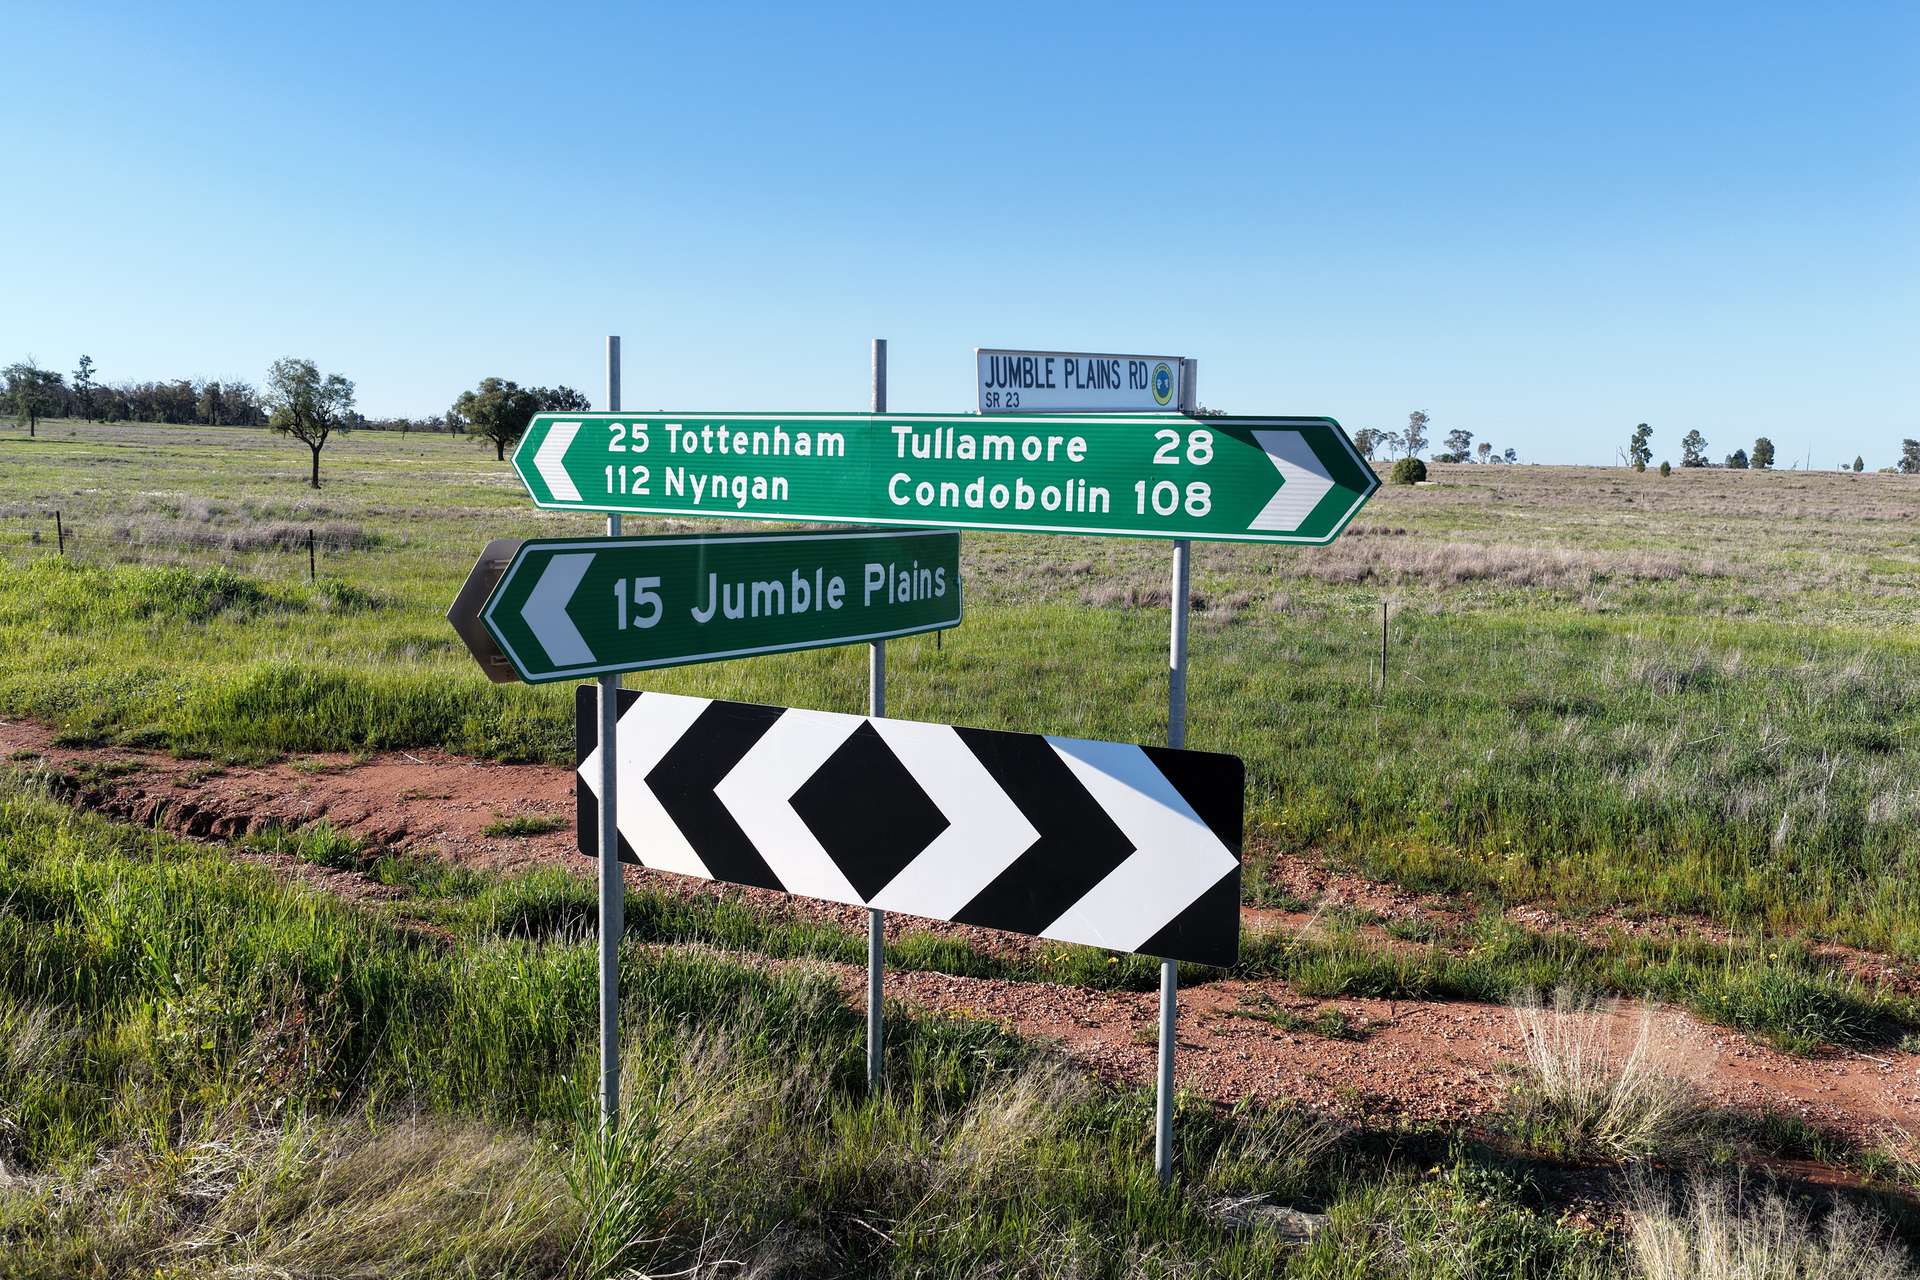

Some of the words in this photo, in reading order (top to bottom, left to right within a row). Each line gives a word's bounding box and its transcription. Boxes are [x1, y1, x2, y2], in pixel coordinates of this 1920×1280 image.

[985, 356, 1056, 389] JUMBLE
[1064, 358, 1121, 390] PLAINS
[1129, 360, 1148, 390] RD
[985, 392, 1000, 408] SR
[1005, 392, 1020, 408] 23
[608, 423, 649, 452] 25
[664, 424, 845, 457] Tottenham
[891, 426, 1088, 462] Tullamore
[1153, 429, 1214, 465] 28
[605, 465, 650, 495] 112
[665, 466, 789, 509] Nyngan
[888, 472, 1110, 513] Condobolin
[1135, 480, 1212, 516] 108
[614, 576, 663, 630] 15
[691, 567, 846, 624] Jumble
[864, 560, 945, 607] Plains
